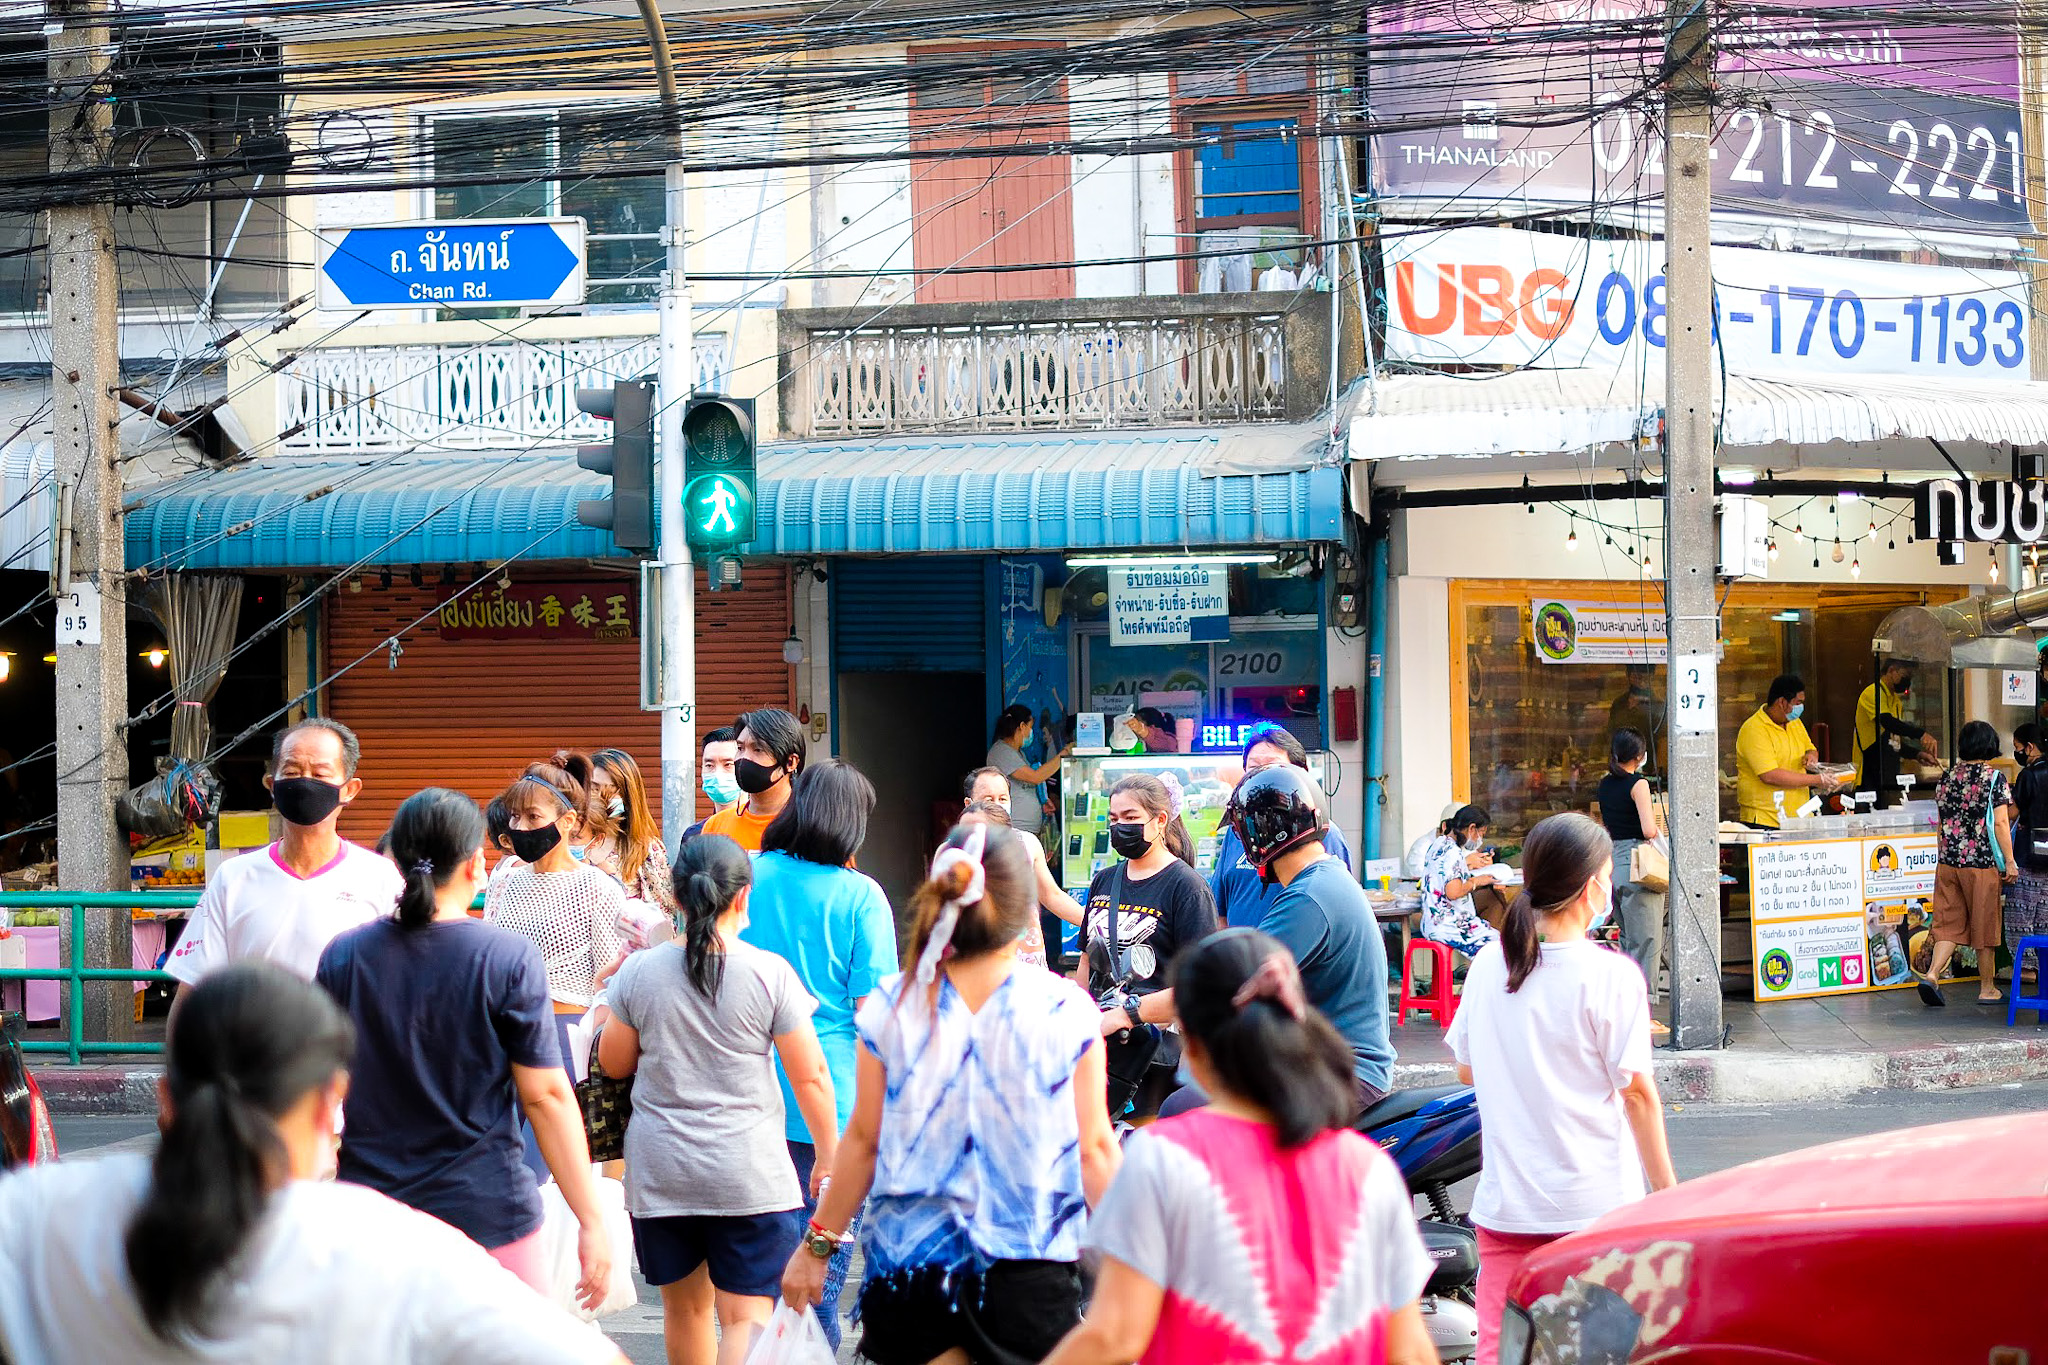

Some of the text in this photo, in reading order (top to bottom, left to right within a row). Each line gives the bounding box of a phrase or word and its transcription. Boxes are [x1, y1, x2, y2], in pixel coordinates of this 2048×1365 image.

[1400, 145, 1553, 170] THANALAND
[409, 282, 492, 299] Chan Rd.
[1396, 262, 2024, 368] UBG 08-170-1133
[1127, 564, 1209, 586] รับซ่อมมือถือ
[65, 616, 87, 631] 95
[1119, 614, 1190, 635] โทรศัพท์มือถือ
[1220, 652, 1282, 674] 2100
[1680, 694, 1705, 709] 97
[1799, 853, 1810, 861] 15
[1812, 851, 1827, 861] บาท
[1760, 886, 1770, 895] 10
[1802, 884, 1808, 893] 2
[1760, 902, 1770, 911] 10
[1803, 900, 1807, 908] 1
[1788, 929, 1798, 937] 50
[1798, 969, 1818, 979] Grab
